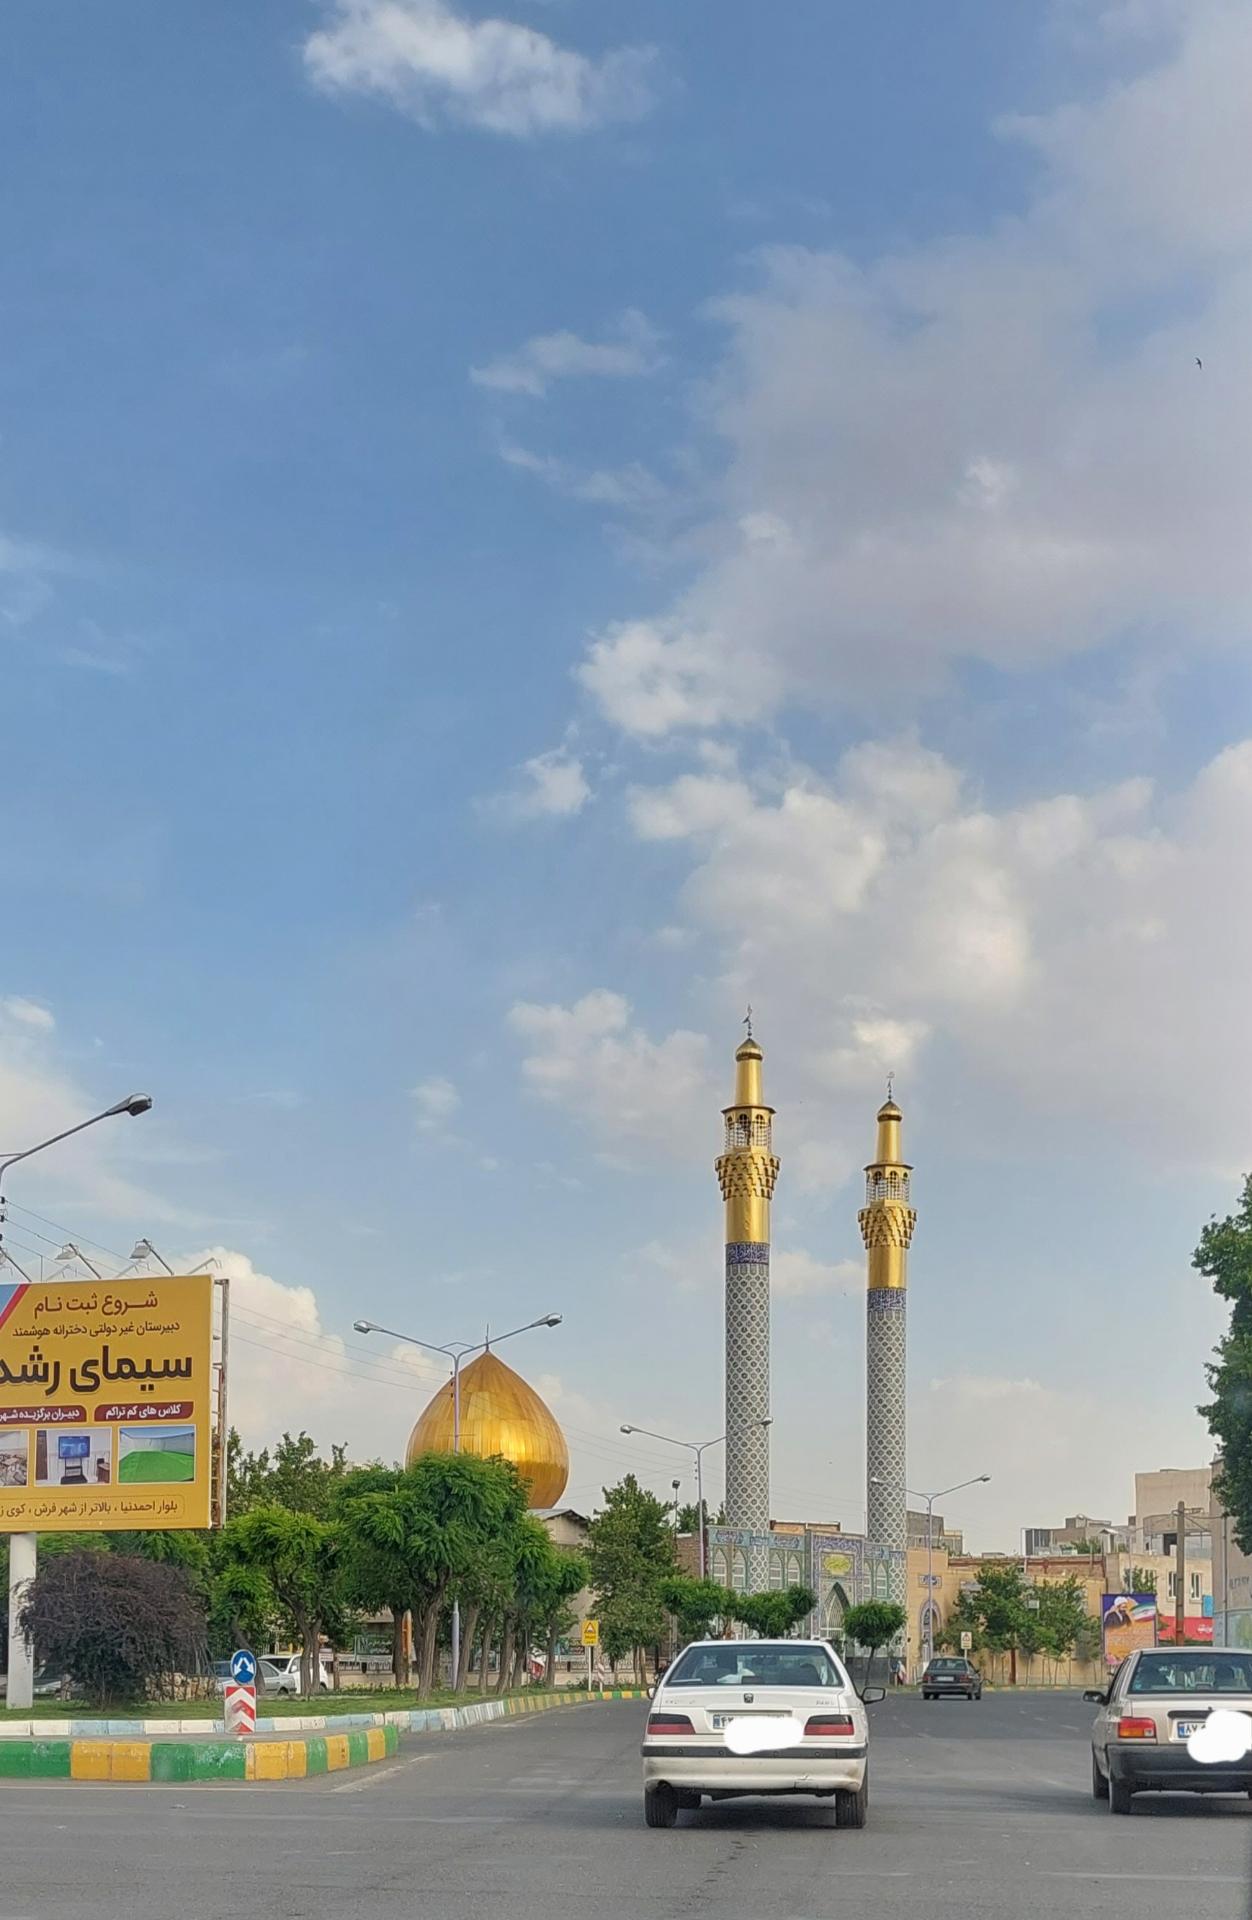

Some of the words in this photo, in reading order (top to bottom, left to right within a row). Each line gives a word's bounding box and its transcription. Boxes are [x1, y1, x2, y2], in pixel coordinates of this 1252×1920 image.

[34, 1296, 62, 1319] نام
[66, 1293, 98, 1315] ثبت
[101, 1291, 158, 1316] شروع
[12, 1325, 51, 1340] هوشمند
[53, 1324, 87, 1339] دخترانه
[89, 1322, 117, 1337] دولتی
[119, 1321, 134, 1336] غیر
[136, 1321, 180, 1336] دبیرستان
[70, 1345, 193, 1393] سیمای
[19, 1407, 50, 1421] برگزیده
[51, 1408, 80, 1420] دبیران
[105, 1406, 126, 1419] تراکم
[127, 1405, 138, 1419] کم
[139, 1405, 157, 1418] های
[158, 1404, 182, 1417] کلاس
[6, 1503, 26, 1517] کوی
[34, 1502, 56, 1517] فرش
[58, 1502, 77, 1516] شهر
[79, 1502, 87, 1516] از
[89, 1501, 111, 1516] بالاتر
[120, 1500, 156, 1514] احمدنیا
[157, 1499, 178, 1514] بلوار
